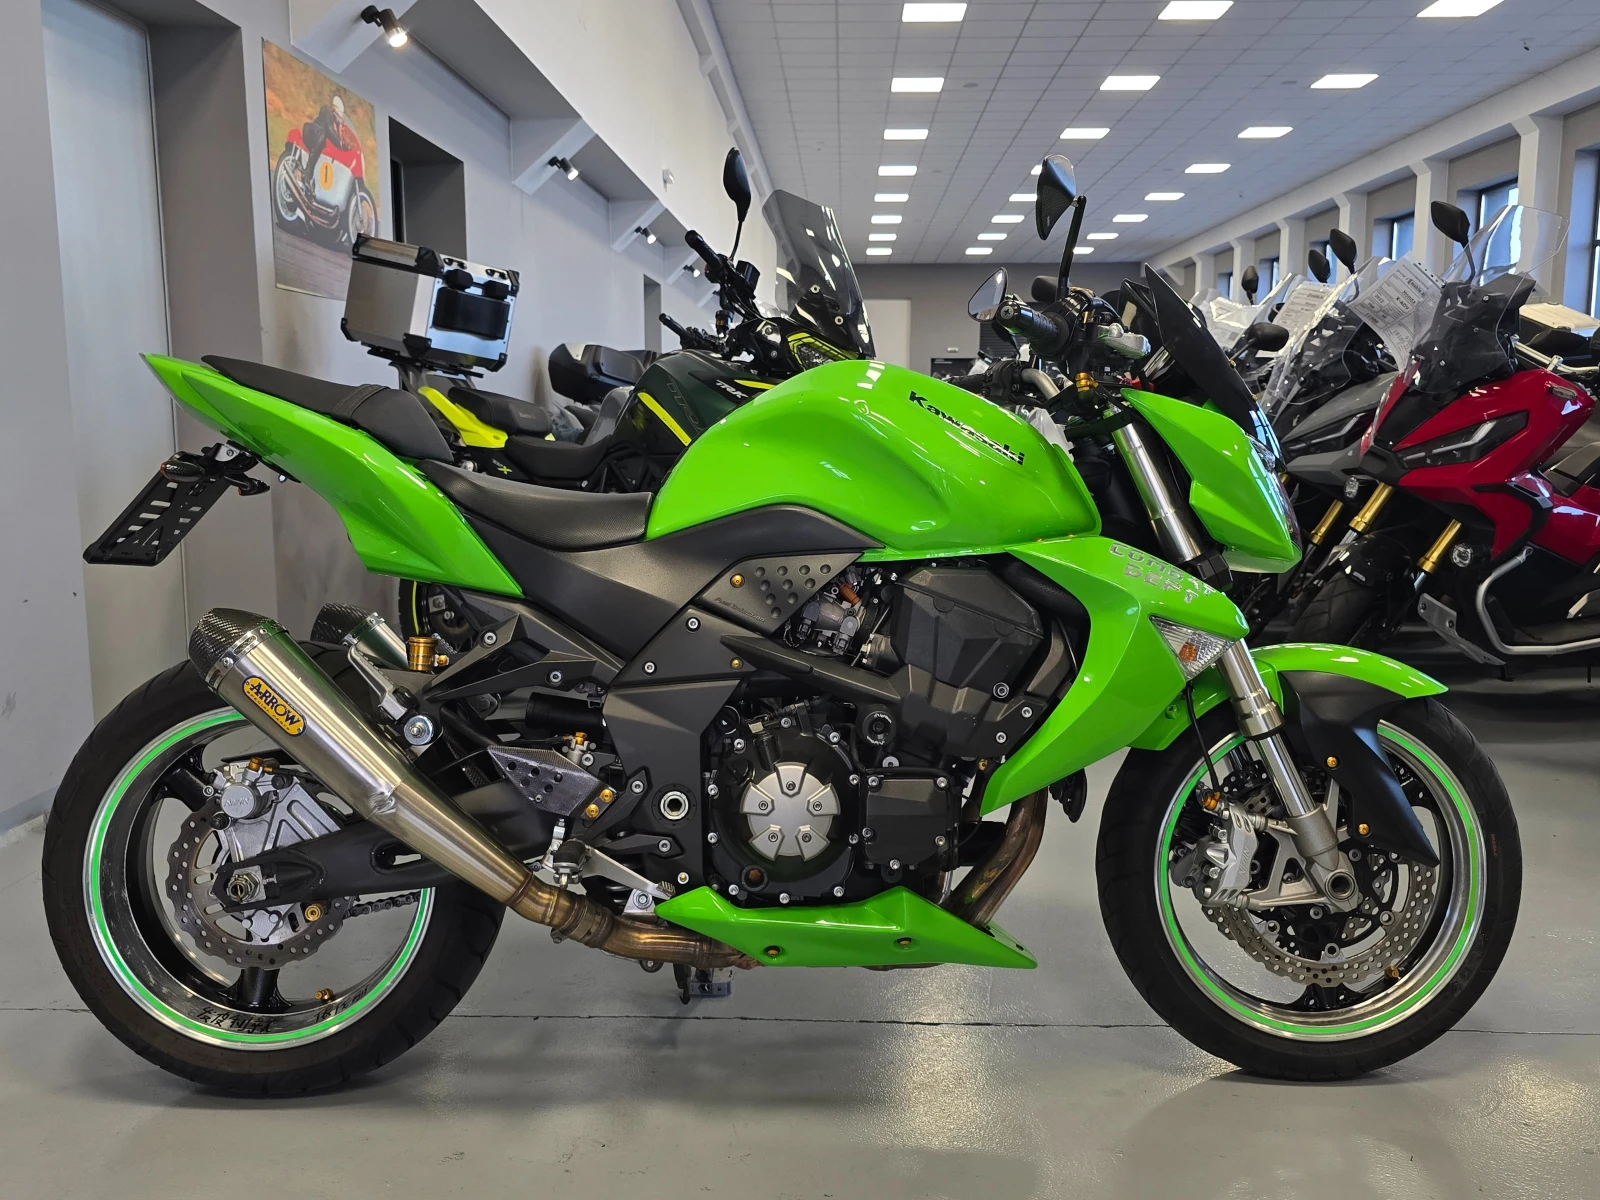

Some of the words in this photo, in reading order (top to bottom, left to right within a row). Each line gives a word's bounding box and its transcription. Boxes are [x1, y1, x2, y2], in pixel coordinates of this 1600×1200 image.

[1396, 296, 1410, 310] X-ADV
[1402, 290, 1416, 304] Honda
[715, 379, 749, 399] TRK
[908, 390, 1025, 466] Kawasaki
[1123, 563, 1199, 604] DEPT
[249, 682, 301, 726] ARROW
